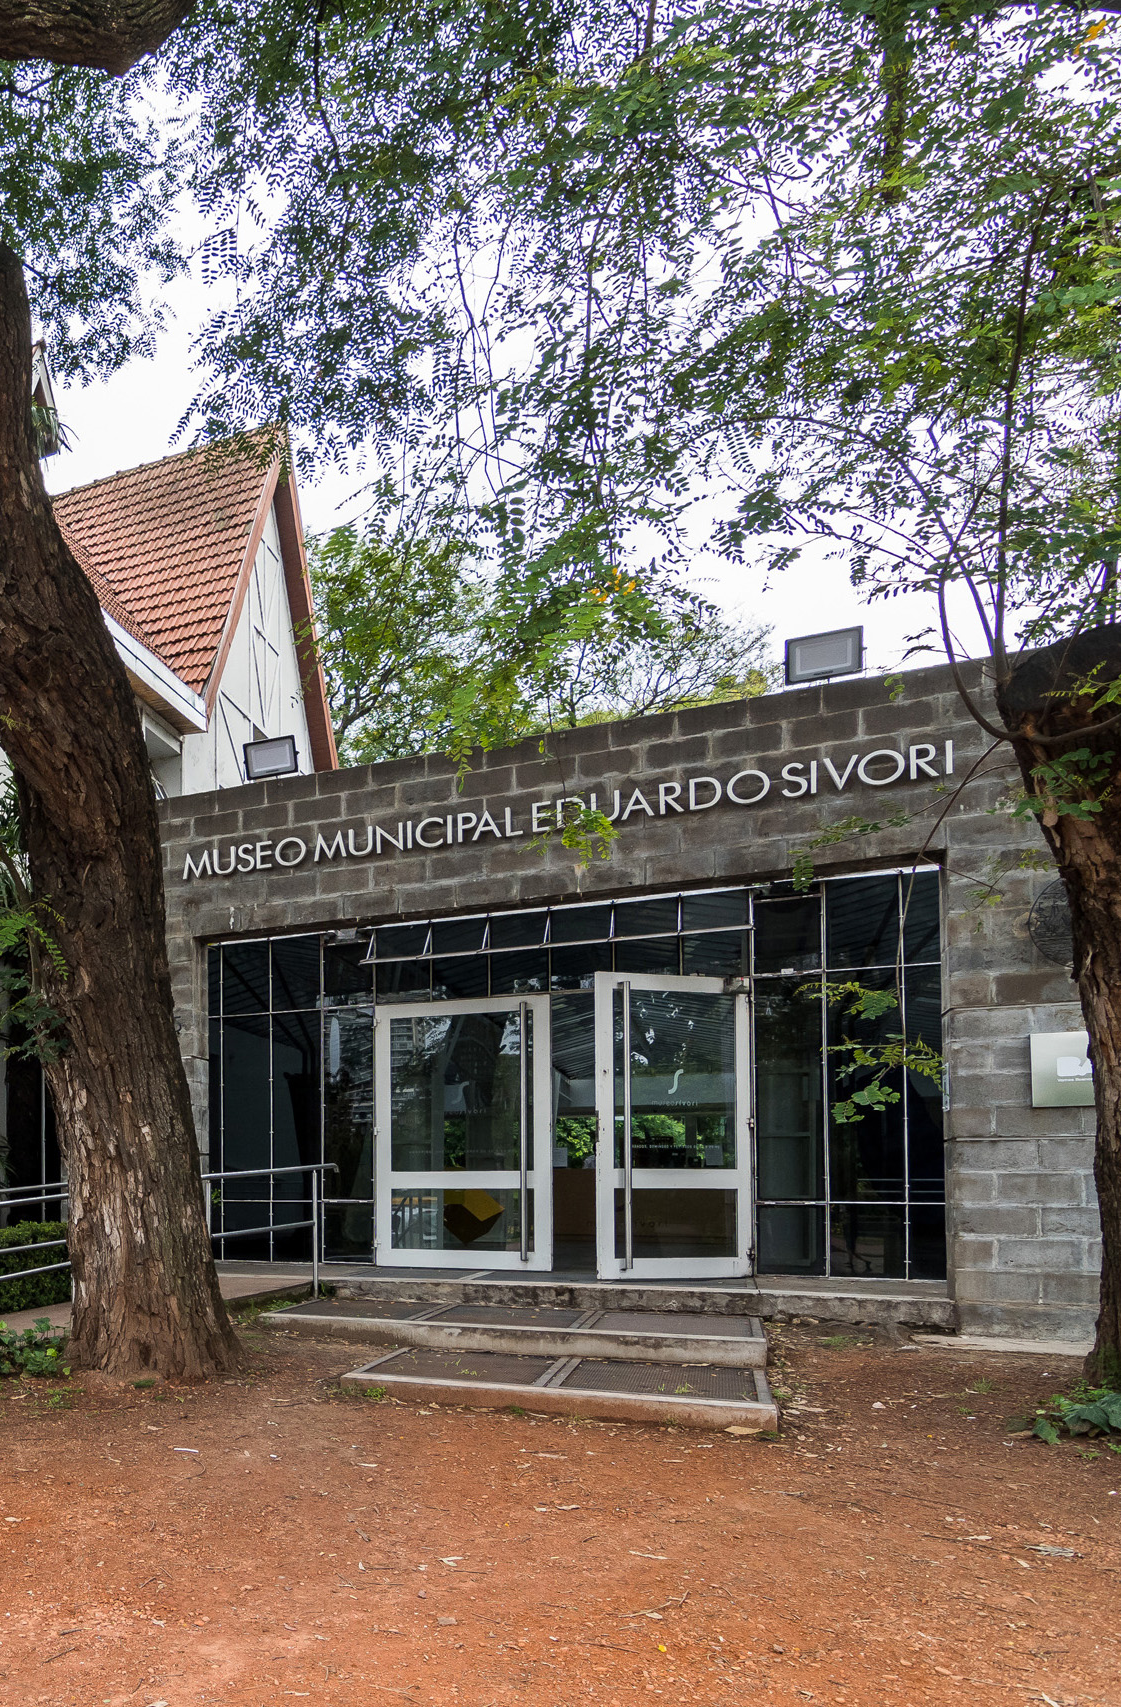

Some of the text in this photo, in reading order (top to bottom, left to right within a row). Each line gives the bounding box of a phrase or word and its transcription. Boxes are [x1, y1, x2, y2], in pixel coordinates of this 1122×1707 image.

[182, 739, 954, 880] MUSEO MUNICIPAL EDUARDO SIVORI
